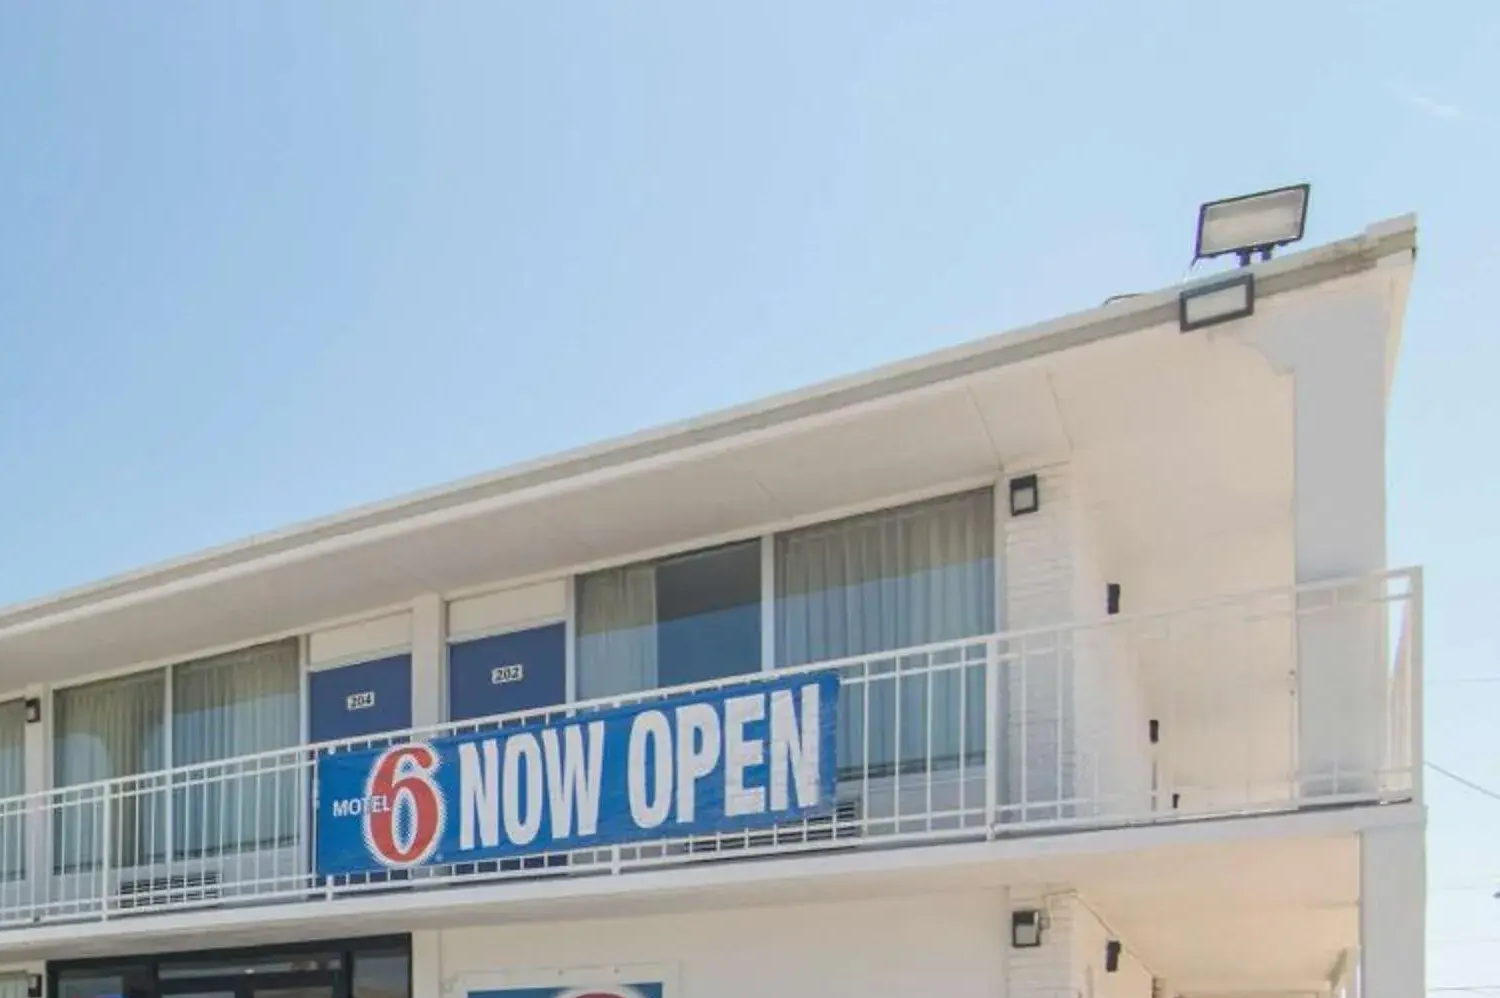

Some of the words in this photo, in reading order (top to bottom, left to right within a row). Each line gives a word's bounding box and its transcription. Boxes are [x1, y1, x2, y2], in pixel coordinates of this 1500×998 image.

[350, 693, 373, 708] 204
[495, 667, 520, 682] 202
[459, 720, 605, 850] NOW
[628, 683, 820, 829] OPEN
[333, 795, 391, 817] MOTEL
[369, 747, 439, 864] 6
